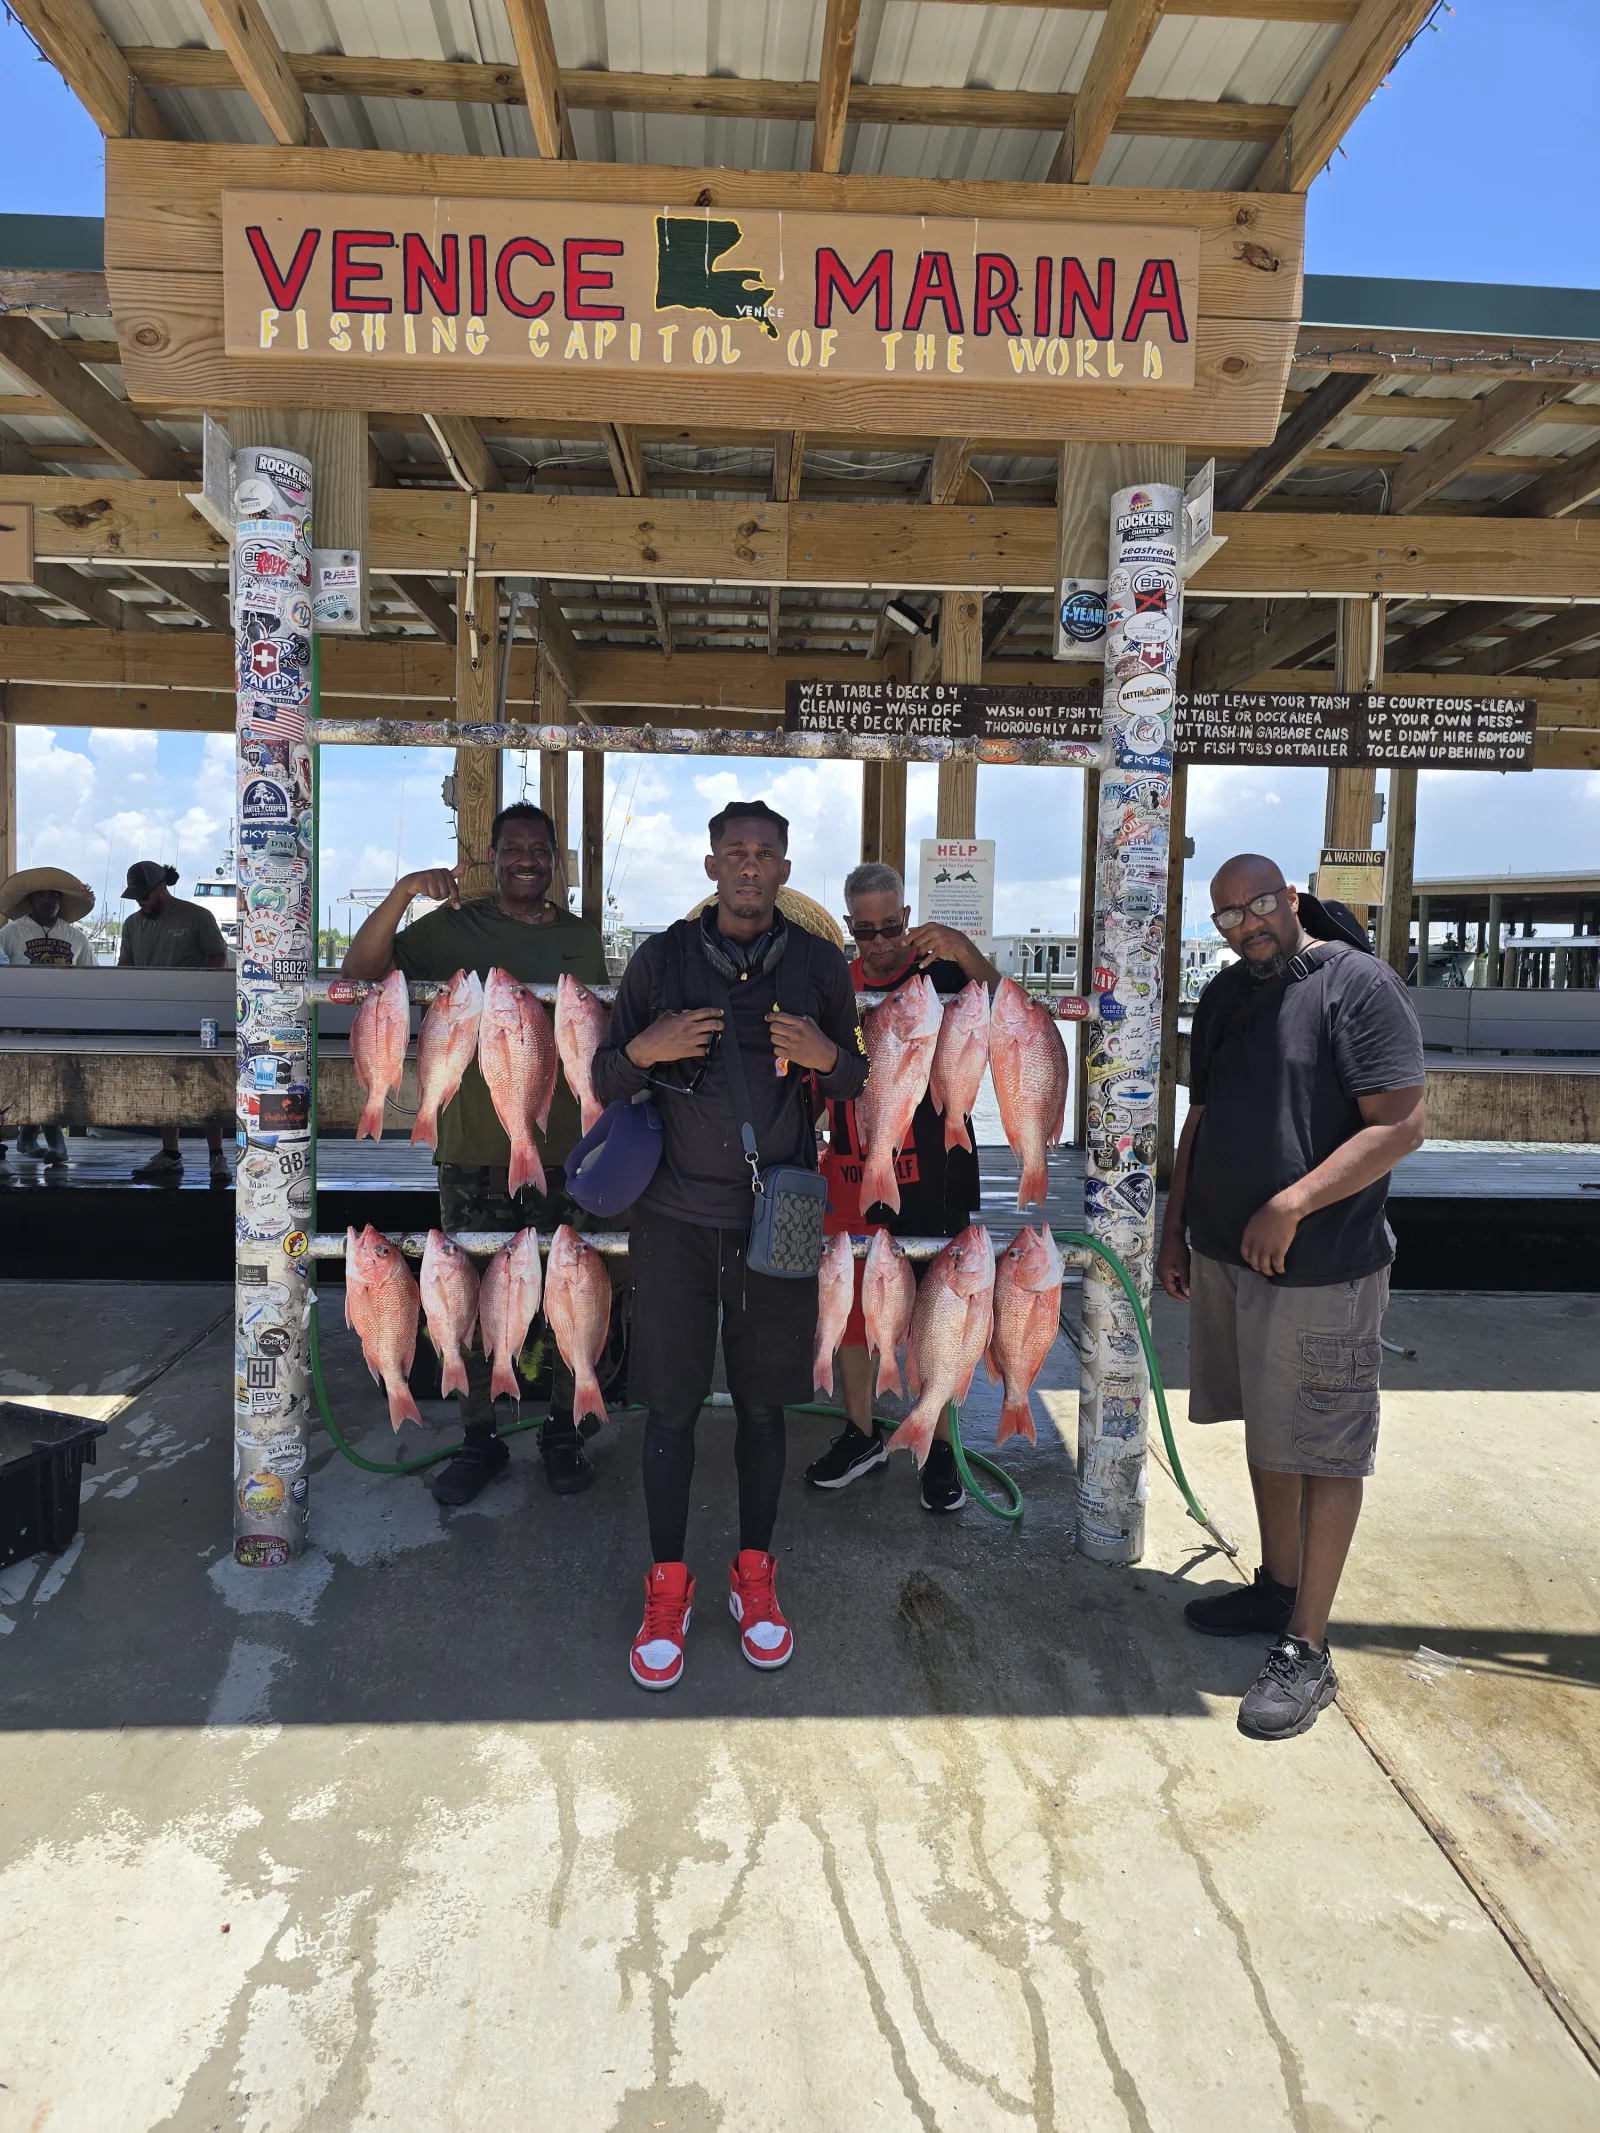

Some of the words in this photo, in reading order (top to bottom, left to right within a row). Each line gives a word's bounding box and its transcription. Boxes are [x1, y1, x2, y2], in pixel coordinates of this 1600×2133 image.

[245, 225, 625, 321] VENICE
[813, 246, 1189, 344] MARINA
[735, 304, 785, 318] VENICE
[259, 308, 490, 355] FISHING
[528, 320, 741, 364] CAPITOL
[787, 328, 839, 368] OF
[881, 333, 965, 373] THE
[1008, 338, 1163, 379] WORLD
[257, 455, 312, 489] ROCKFISH
[261, 520, 294, 533] BORN
[1118, 512, 1175, 531] ROCKFISH
[1122, 546, 1175, 558] seastreak
[1140, 578, 1174, 590] BBW
[313, 598, 327, 610] ALTY
[799, 683, 834, 697] WET
[841, 684, 883, 699] TABLE
[896, 685, 930, 700] DECK
[799, 698, 871, 715] CLEANING
[885, 702, 927, 716] WASH
[931, 703, 962, 717] OFF
[1193, 693, 1220, 707] NOT
[1224, 694, 1266, 708] LEAVE
[1270, 695, 1305, 709] YOUR
[1309, 695, 1350, 710] TRASH
[1367, 696, 1386, 709] BE
[985, 705, 1025, 718] WASH
[1027, 705, 1053, 718] OUT
[1057, 706, 1086, 719] FISH
[1088, 707, 1104, 719] TU
[1190, 708, 1230, 723] TABLE
[1234, 710, 1252, 723] OR
[1255, 711, 1288, 724] DOCK
[1289, 711, 1323, 725] AREA
[1368, 713, 1388, 725] UP
[1391, 713, 1430, 726] YOUR
[1434, 713, 1472, 727] OWN
[800, 715, 846, 730] TABLE
[863, 717, 905, 731] DECK
[984, 720, 1068, 736] THOROUGHLY
[1071, 723, 1103, 736] AFTE
[1194, 723, 1236, 738] TRASH
[1256, 726, 1312, 741] GARBAGE
[1314, 727, 1350, 742] CANS
[1368, 728, 1392, 742] WE
[1443, 730, 1474, 744] HIRE
[1477, 730, 1533, 745] SOMEONE
[1203, 741, 1236, 755] FISH
[1238, 741, 1273, 756] TUBS
[1274, 744, 1292, 756] OR
[1291, 742, 1349, 757] TRAILER
[1366, 744, 1384, 757] TO
[1385, 744, 1428, 759] CLEAN
[1429, 746, 1447, 759] UP
[1447, 746, 1496, 761] BEHIND
[1498, 747, 1526, 759] YOU
[265, 804, 286, 813] COOPER
[271, 840, 293, 849] DMJ
[937, 844, 978, 857] HELP
[1334, 851, 1381, 863] WARNING
[274, 961, 307, 974] 98022
[853, 1025, 867, 1056] SPORT
